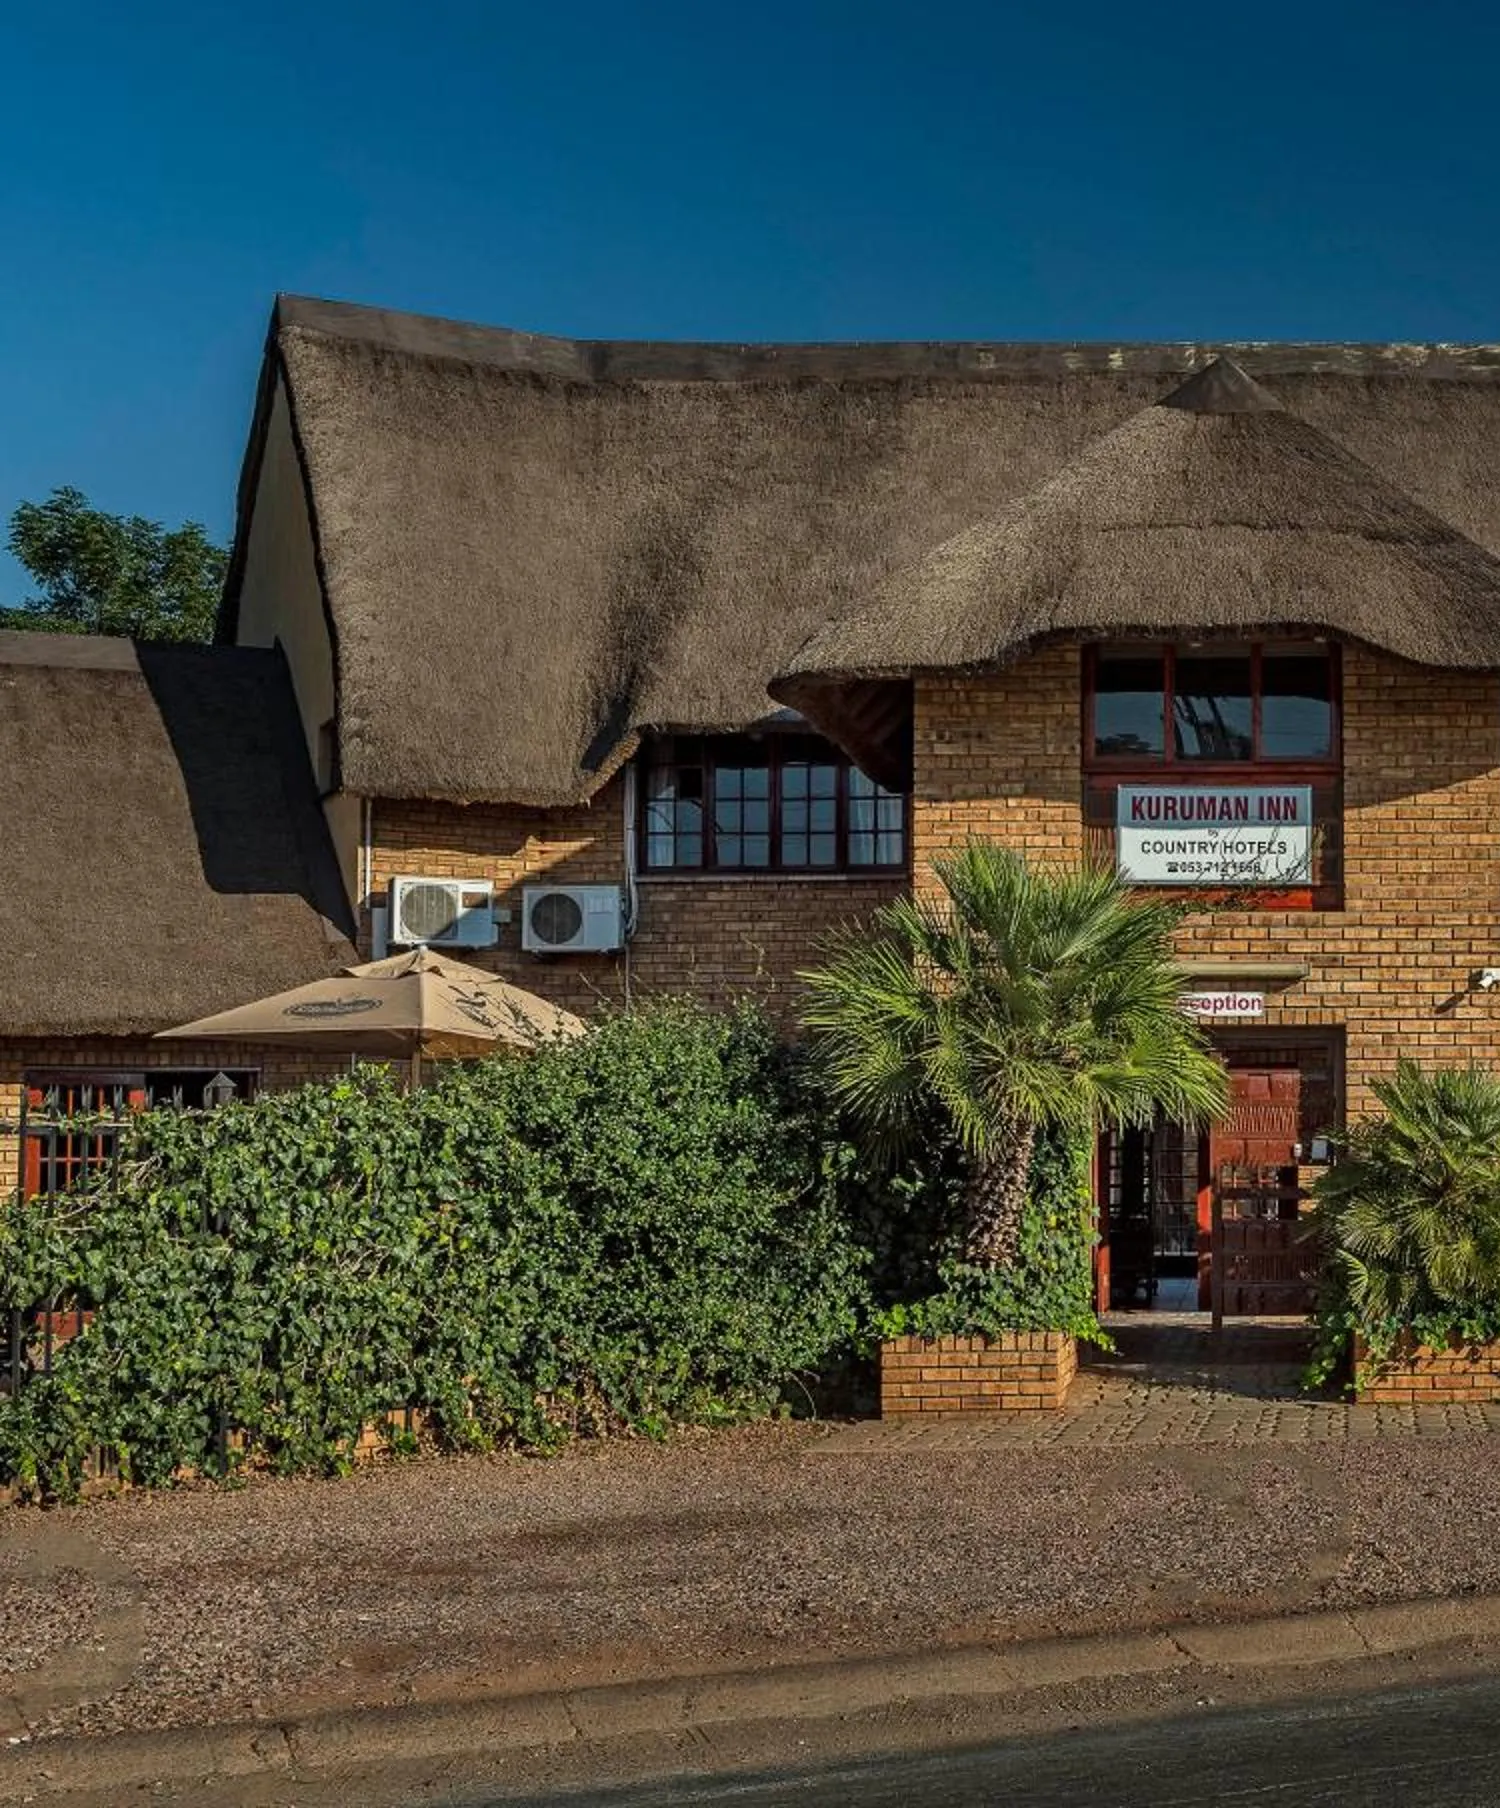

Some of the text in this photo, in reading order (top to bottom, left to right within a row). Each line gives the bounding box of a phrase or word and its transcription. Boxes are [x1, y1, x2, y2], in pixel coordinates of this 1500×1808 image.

[1131, 796, 1297, 821] KURUMAN INN
[1140, 841, 1287, 855] COUNTRY HOTELS
[1188, 994, 1262, 1014] eption
